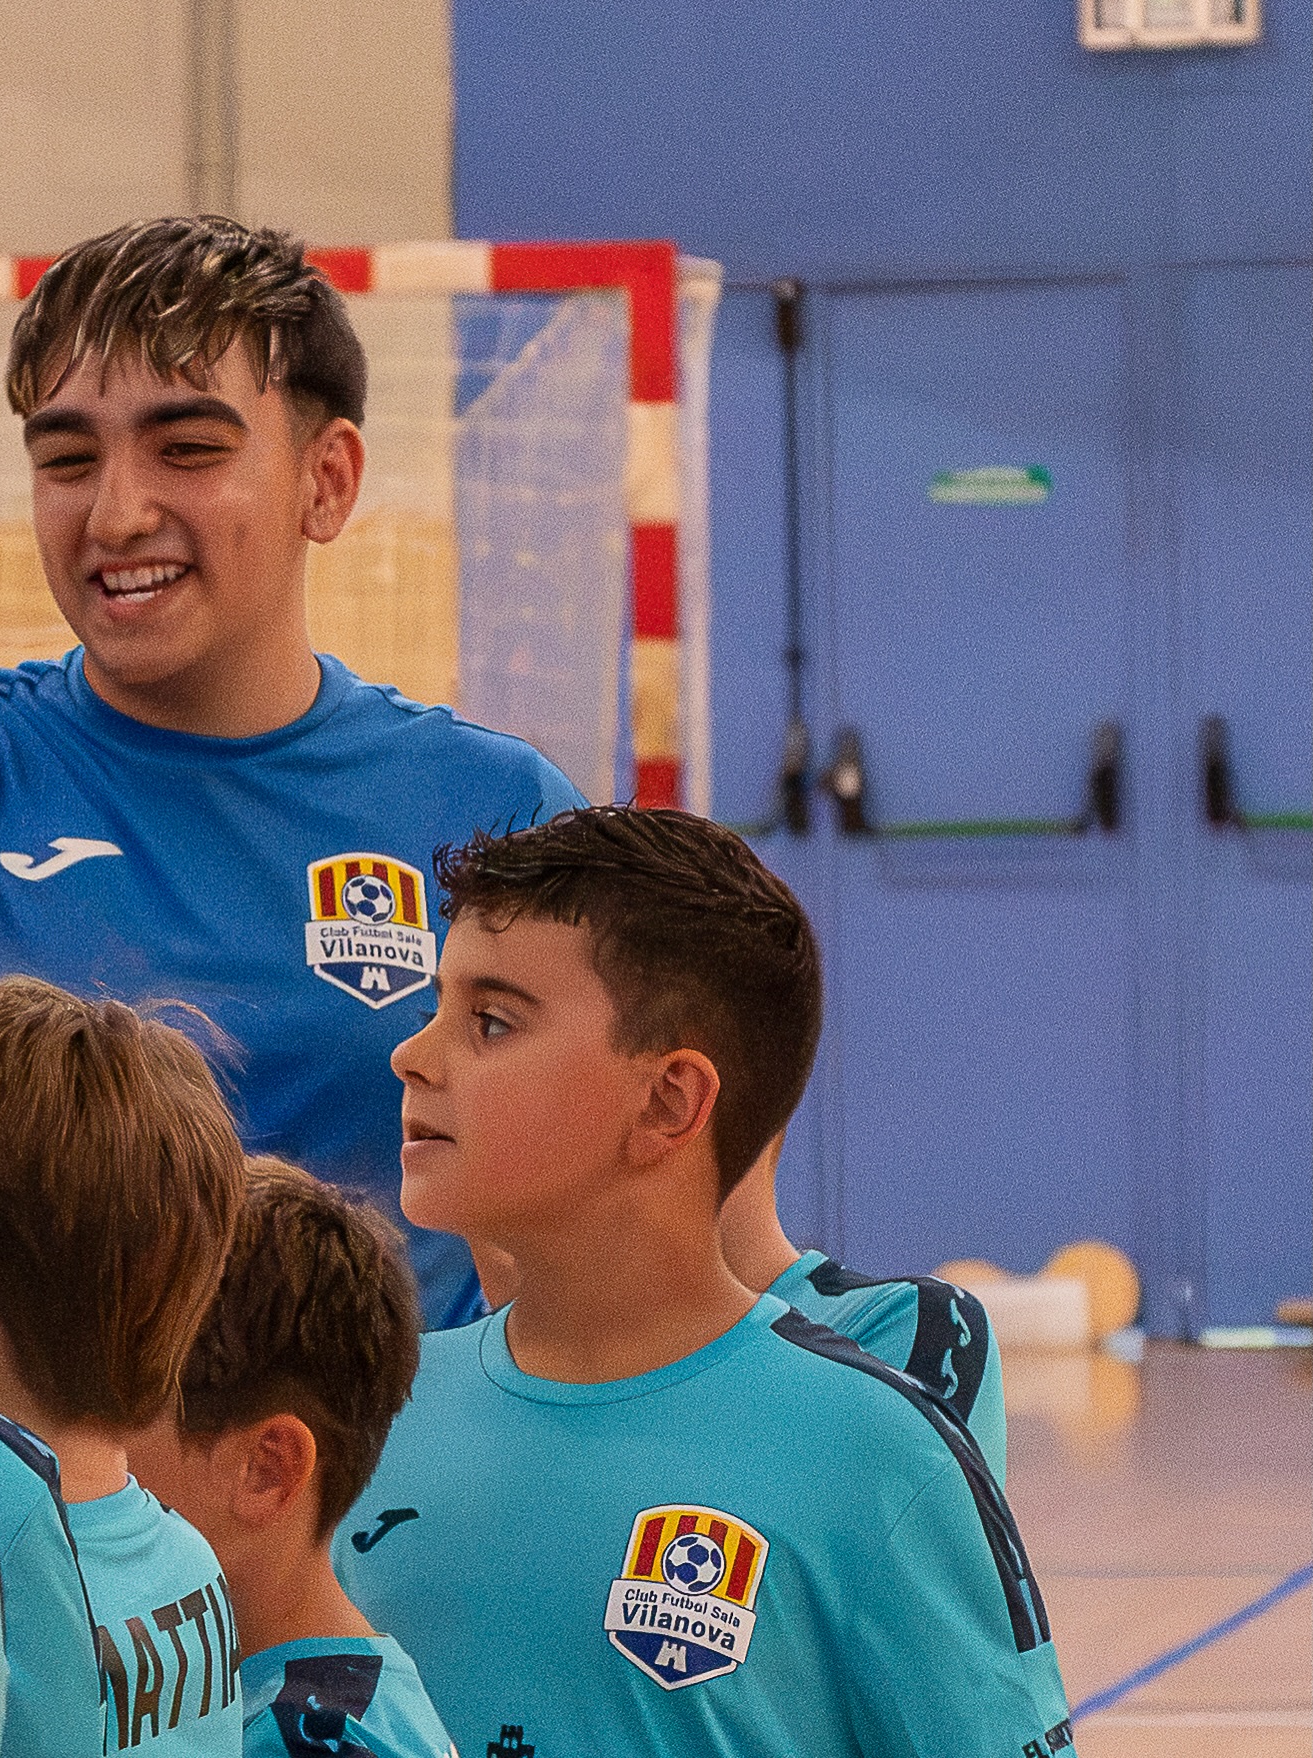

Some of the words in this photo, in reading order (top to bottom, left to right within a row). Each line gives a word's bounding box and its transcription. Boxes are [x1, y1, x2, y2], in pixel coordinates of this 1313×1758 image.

[320, 926, 349, 938] Club
[352, 925, 393, 939] Futbol
[397, 931, 423, 947] Sala
[320, 937, 424, 968] Vilanova
[624, 1588, 658, 1603] Club
[661, 1592, 708, 1615] Futbol
[710, 1606, 741, 1628] Sala
[622, 1602, 736, 1651] Vilanova
